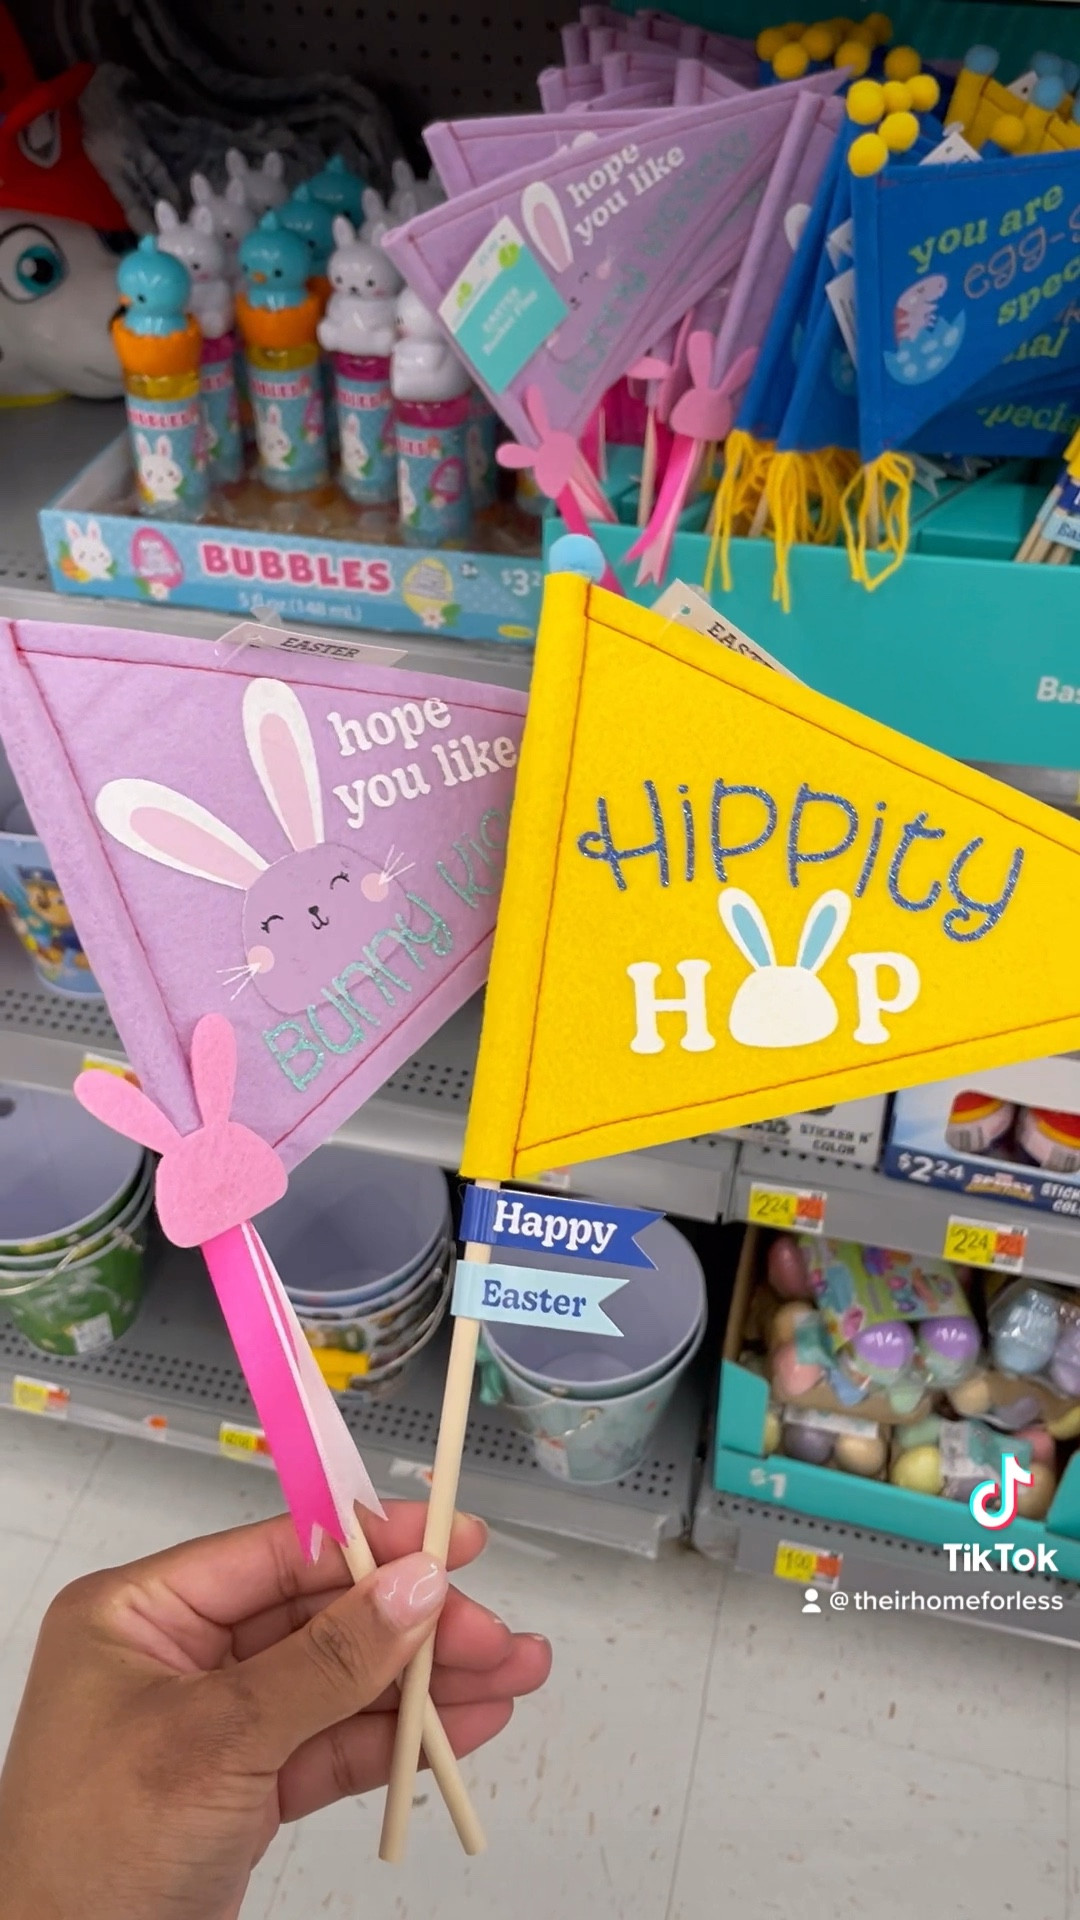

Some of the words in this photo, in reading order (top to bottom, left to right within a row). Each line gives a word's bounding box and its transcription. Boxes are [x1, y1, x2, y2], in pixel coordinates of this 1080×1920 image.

[566, 143, 640, 208] hope
[573, 190, 629, 247] you
[627, 146, 686, 197] like
[908, 217, 988, 274] you
[999, 185, 1064, 237] are
[201, 542, 392, 595] BUBBLES
[279, 636, 361, 660] EASTER
[327, 697, 452, 756] hope
[332, 761, 432, 830] you
[432, 734, 518, 787] like
[492, 1199, 619, 1255] Happy
[481, 1278, 587, 1318] Easter
[751, 1468, 787, 1499] $1
